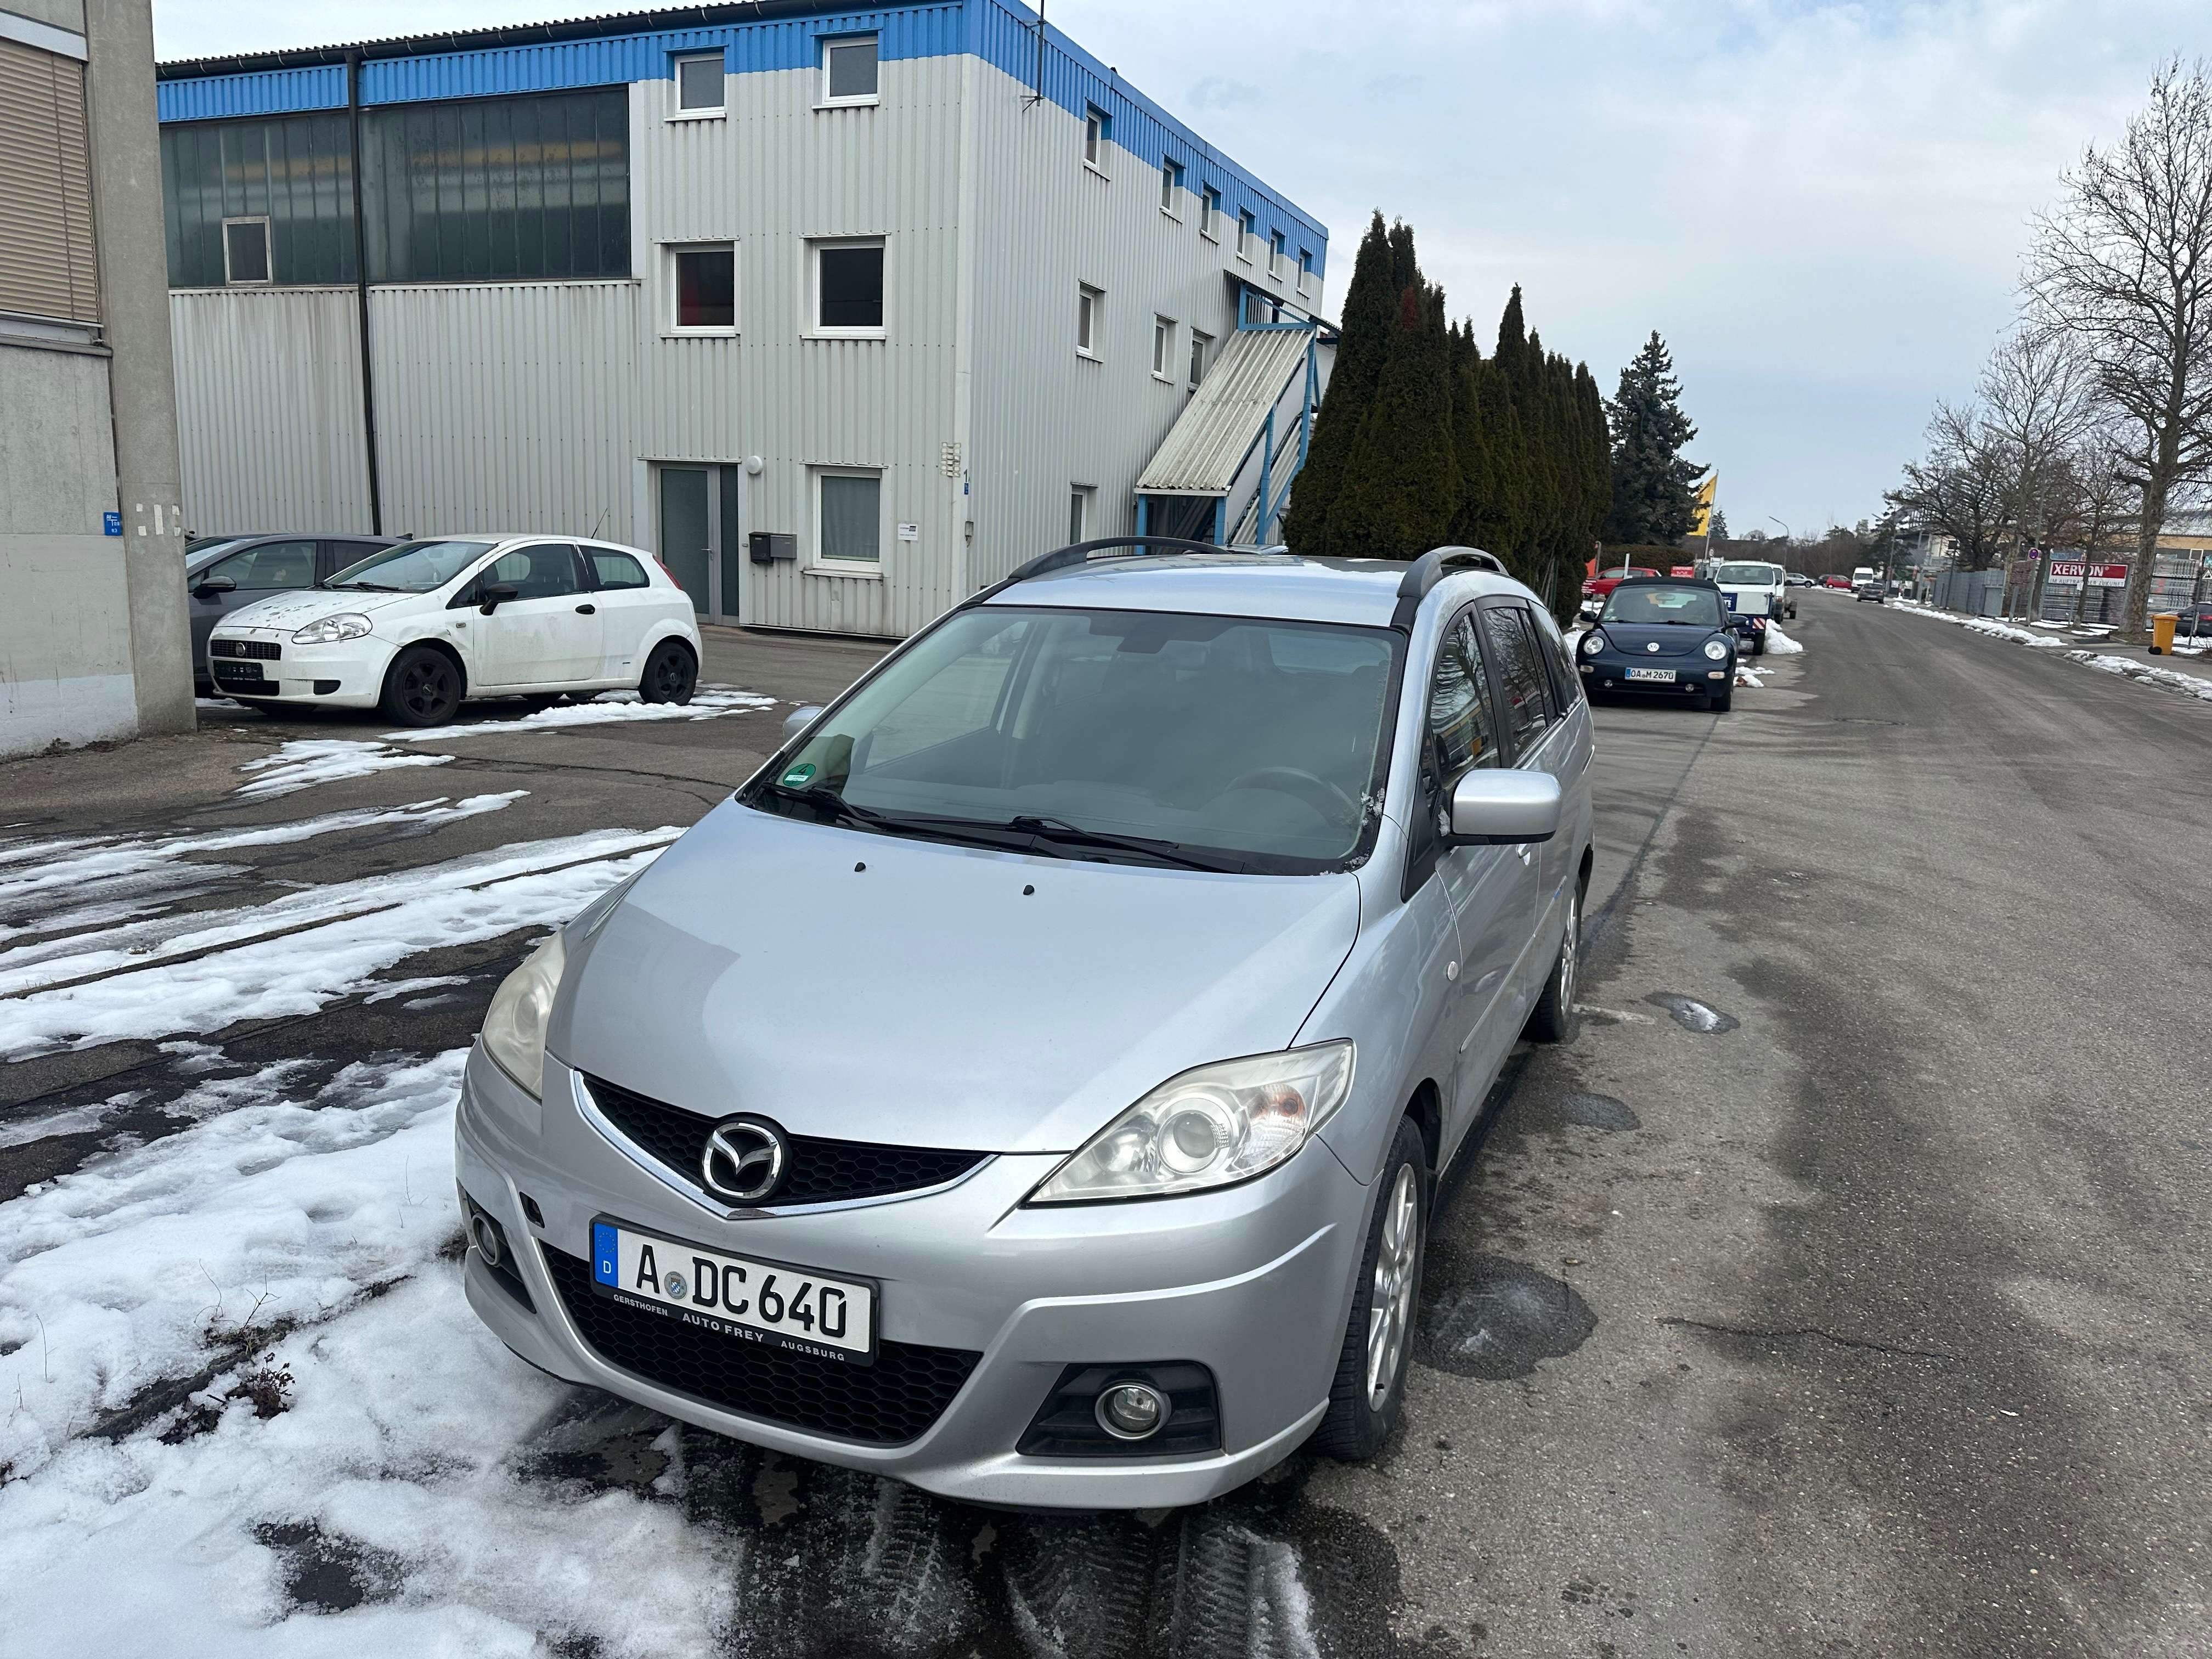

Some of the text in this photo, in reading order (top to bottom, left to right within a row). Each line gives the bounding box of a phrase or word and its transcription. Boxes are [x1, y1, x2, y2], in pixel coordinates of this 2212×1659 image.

[1654, 672, 1674, 680] 2670
[797, 764, 810, 775] 4
[603, 1260, 611, 1274] D
[636, 1244, 847, 1338] A DC 640
[613, 1294, 845, 1361] GERSTHOFEN AUTO FREY AUGSBURG
